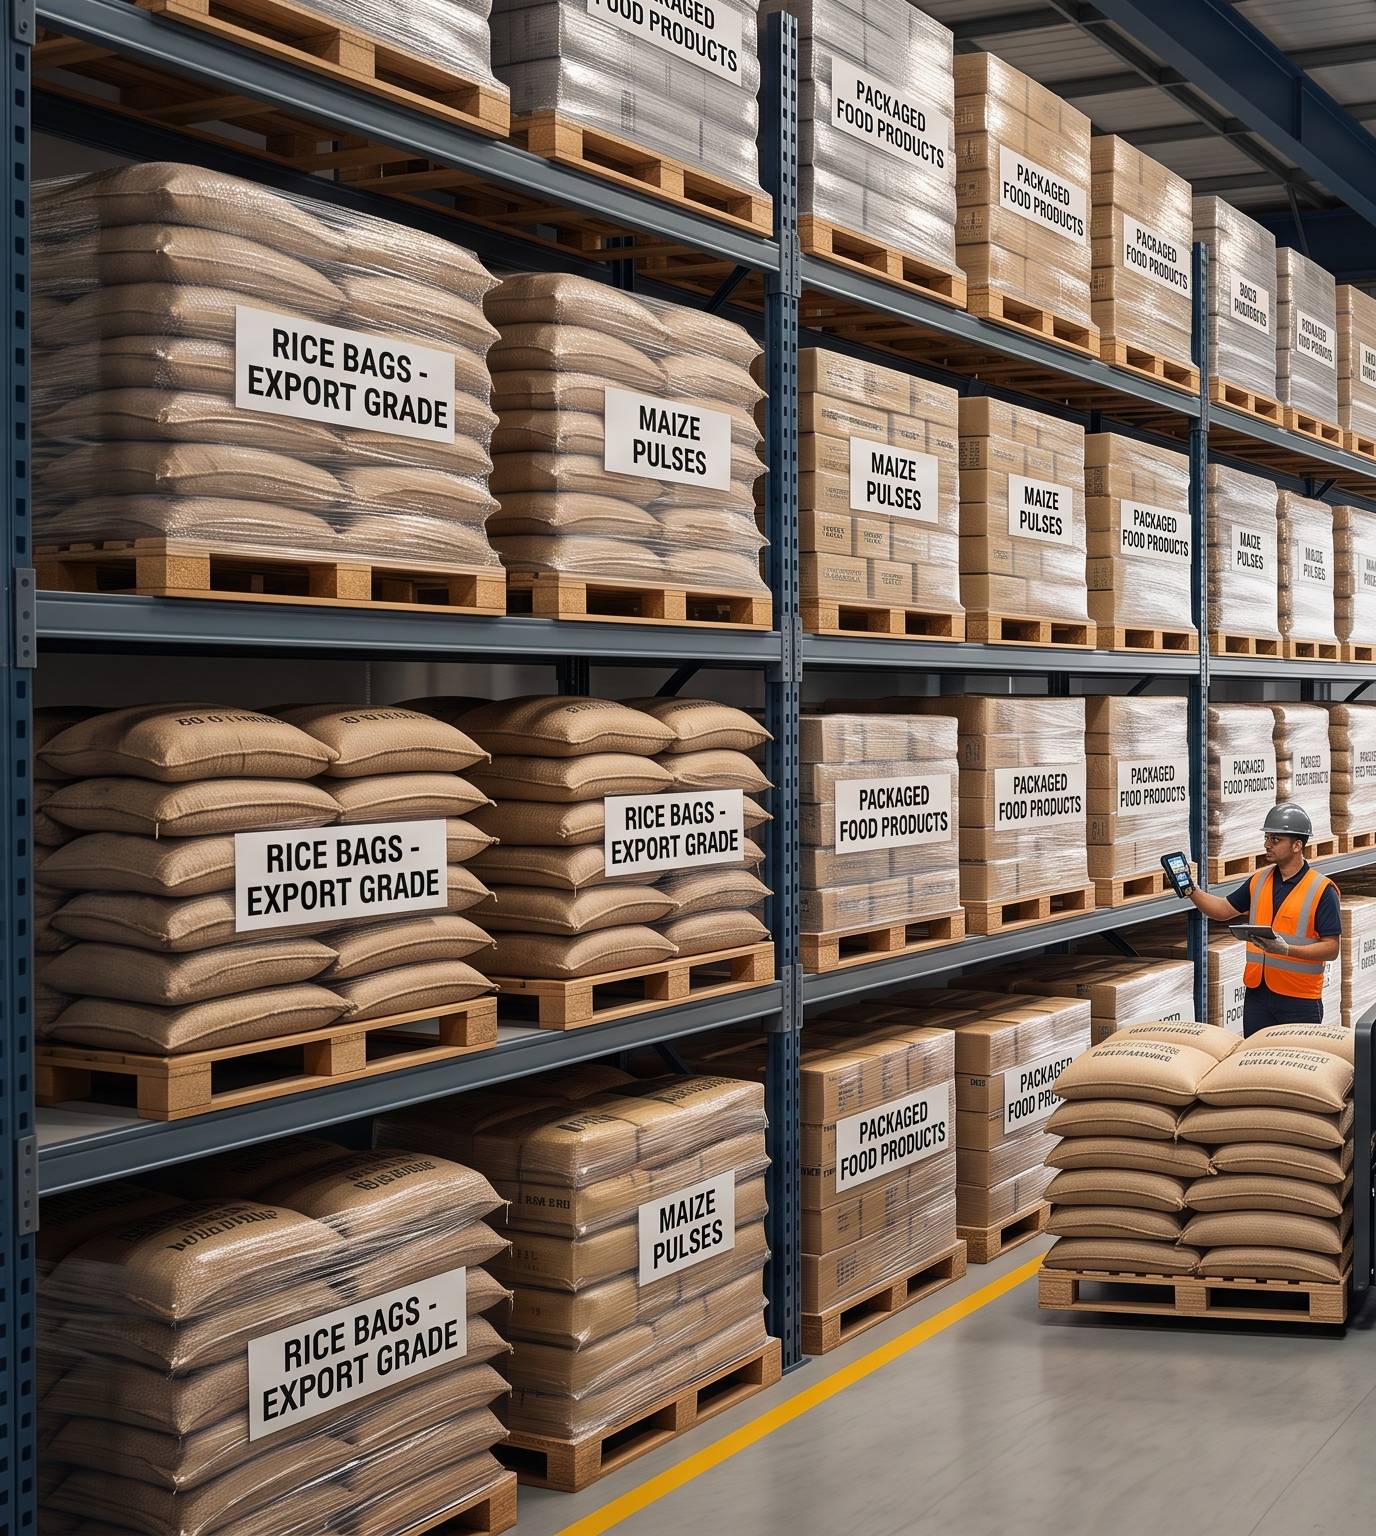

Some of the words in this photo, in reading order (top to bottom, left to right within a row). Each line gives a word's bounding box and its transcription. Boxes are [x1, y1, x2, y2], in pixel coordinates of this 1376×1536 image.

[649, 9, 738, 72] PRODUCTS
[856, 79, 926, 133] PACKAGED
[837, 97, 874, 134] FOOD
[877, 118, 944, 169] PRODUCTS
[1017, 163, 1070, 206] PACKAGED
[1003, 181, 1031, 210] FOOD
[1033, 196, 1083, 237] PRODUCTS
[272, 327, 335, 369] RICE
[343, 342, 412, 384] BAGS
[248, 364, 357, 412] EXPORT
[364, 387, 448, 429] GRADE
[639, 404, 701, 442] MAIZE
[633, 438, 707, 476] PULSES
[871, 451, 917, 482] MAIZE
[866, 480, 922, 511] PULSES
[1024, 485, 1059, 511] MAIZE
[1019, 509, 1063, 536] PULSES
[1122, 529, 1146, 549] FOOD
[1133, 509, 1177, 534] PACKAGED
[1013, 773, 1068, 795] PACKAGED
[1131, 765, 1175, 785] PACKAGED
[626, 804, 666, 831] RICE
[670, 800, 715, 827] BAGS
[859, 785, 930, 811] PACKAGED
[999, 800, 1028, 822] FOOD
[839, 817, 878, 842] FOOD
[881, 811, 948, 838] PRODUCTS
[266, 839, 328, 874] RICE
[336, 834, 403, 868] BAGS
[611, 834, 681, 865] EXPORT
[685, 828, 739, 857] GRADE
[247, 877, 352, 917] EXPORT
[359, 868, 440, 904] GRADE
[859, 1101, 928, 1145] PACKAGED
[1008, 1095, 1036, 1123] FOOD
[840, 1147, 877, 1181] FOOD
[880, 1121, 946, 1165] PRODUCTS
[660, 1188, 716, 1234] MAIZE
[653, 1218, 723, 1270] PULSES
[284, 1321, 346, 1372] RICE
[354, 1296, 420, 1347] BAGS
[263, 1352, 369, 1422] EXPORT
[376, 1319, 458, 1377] GRADE
